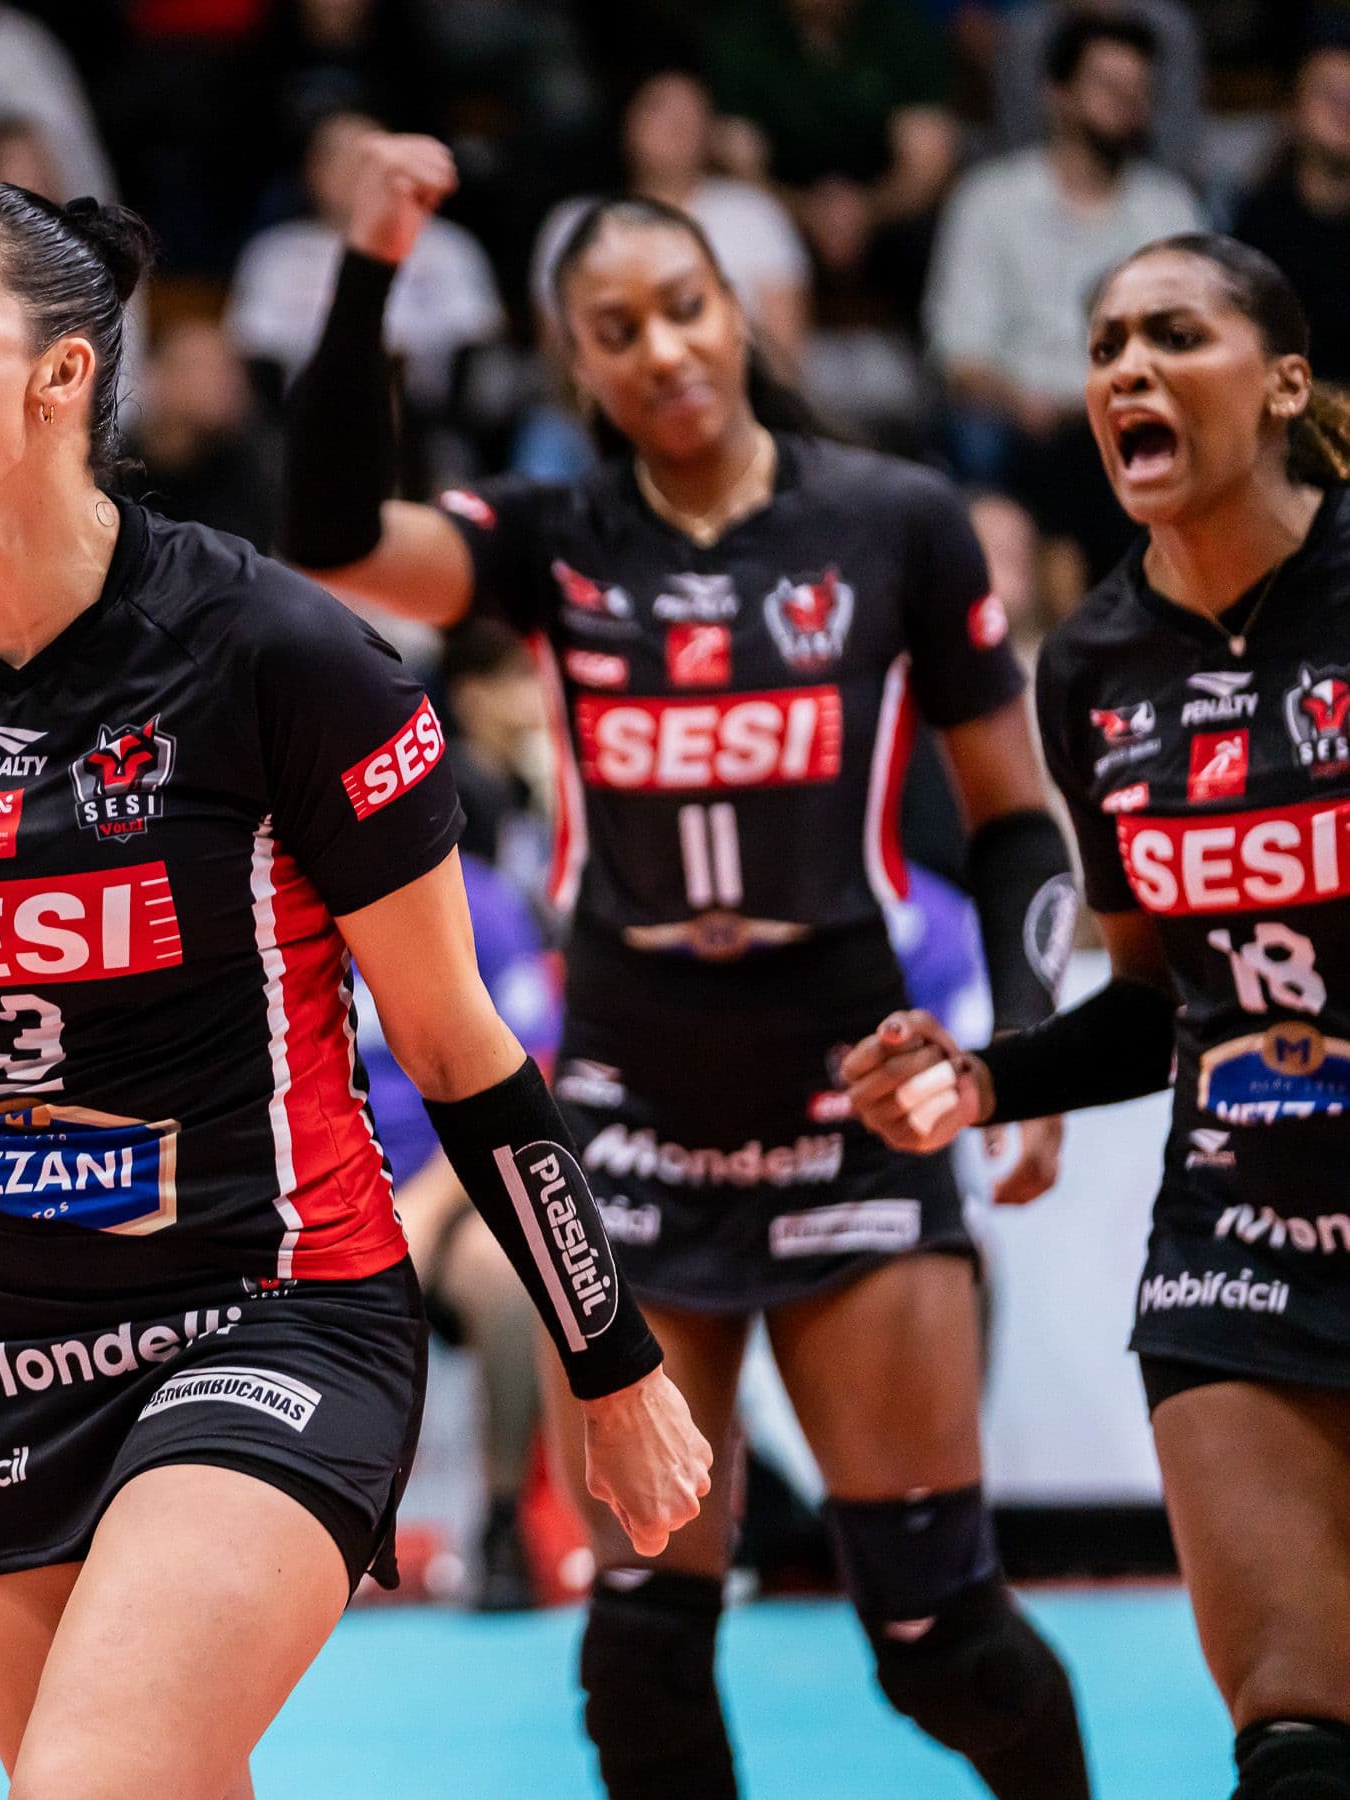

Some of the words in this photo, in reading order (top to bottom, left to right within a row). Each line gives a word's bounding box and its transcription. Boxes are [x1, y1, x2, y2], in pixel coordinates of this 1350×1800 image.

[595, 697, 818, 788] SESI
[83, 794, 155, 823] SESI
[678, 803, 744, 908] 11
[1131, 810, 1340, 913] SESI
[1208, 922, 1327, 1014] 18
